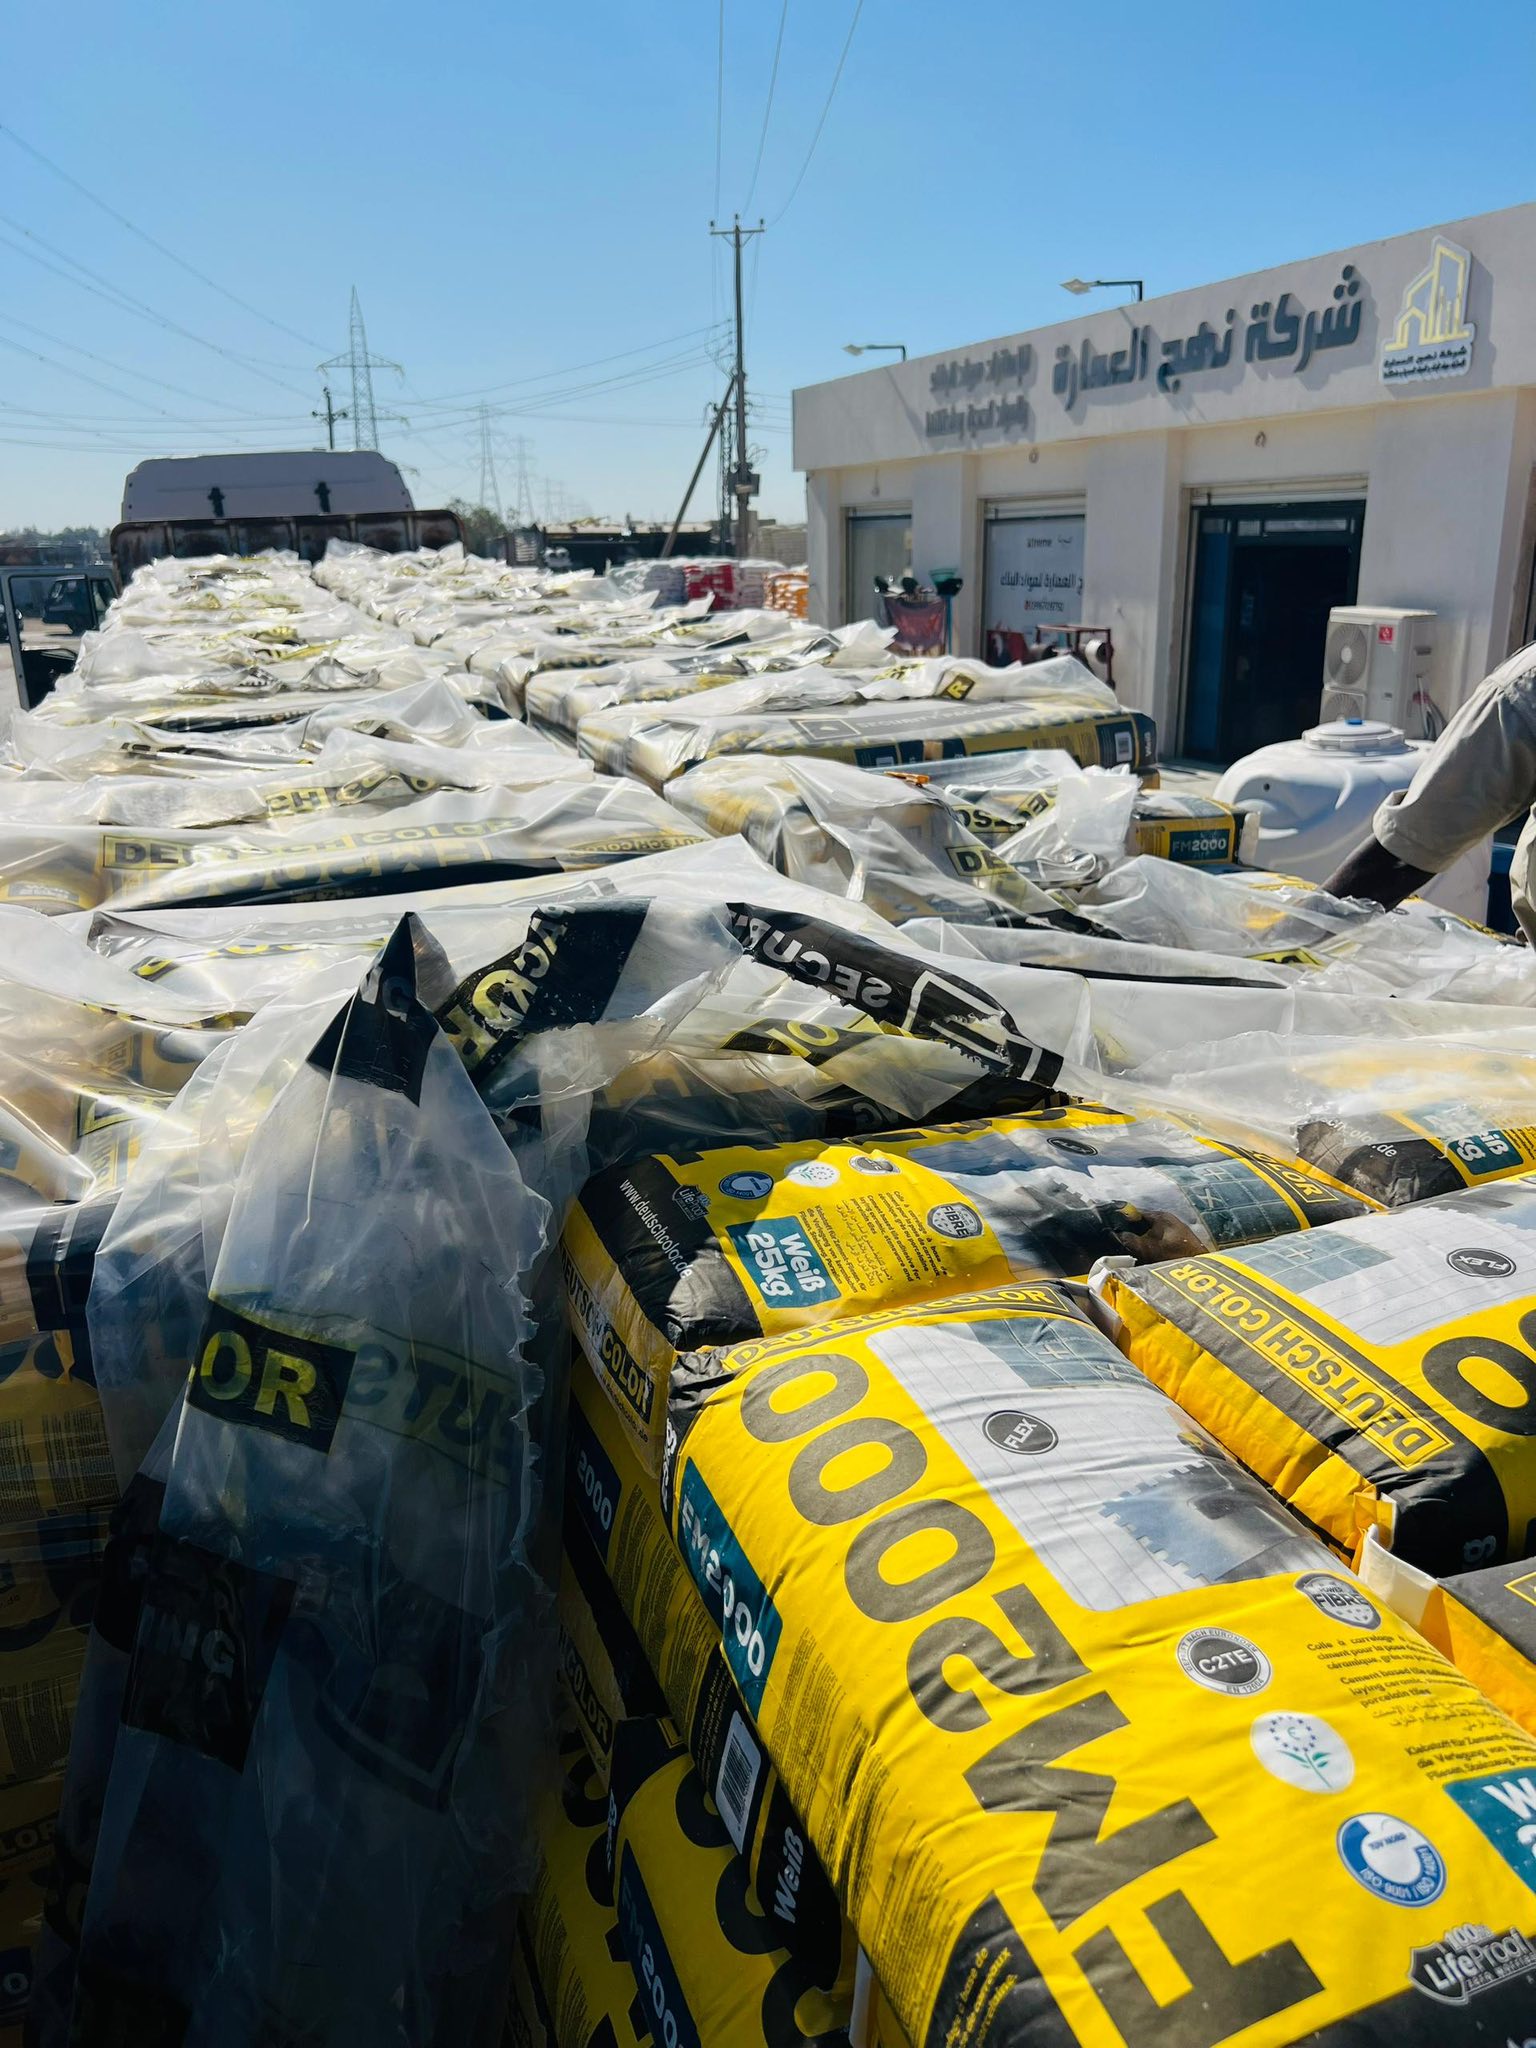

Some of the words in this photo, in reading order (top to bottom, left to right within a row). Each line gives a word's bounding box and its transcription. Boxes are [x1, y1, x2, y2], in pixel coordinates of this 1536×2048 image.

[1158, 307, 1237, 394] نهج
[1244, 264, 1362, 374] شركة
[1053, 324, 1149, 412] العمارة
[1172, 837, 1228, 852] FM2000
[619, 1178, 693, 1280] www.deutschcolor.de
[941, 1202, 974, 1240] FIBRE
[747, 1231, 794, 1297] 25kg
[780, 1232, 826, 1293] Weiß
[1455, 1254, 1511, 1274] FLEX
[732, 1305, 919, 1367] DEUTSCH
[926, 1287, 1055, 1310] COLOR
[1168, 1263, 1272, 1331] COLOR
[200, 1330, 318, 1429] OR
[1263, 1325, 1434, 1457] DEUTSCH
[1005, 1417, 1039, 1450] FLEX
[680, 1493, 766, 1677] FM2000
[1313, 1591, 1370, 1610] FIBRE
[1197, 1648, 1254, 1675] C2TE
[1339, 1670, 1380, 1686] Cement
[740, 1353, 1326, 2048] FM2000
[1360, 1688, 1410, 1709] porcelain
[773, 1825, 806, 1924] Weiß
[973, 1946, 1012, 2014] carreaux
[974, 1946, 989, 1969] de
[1423, 1927, 1531, 1992] LifeProof
